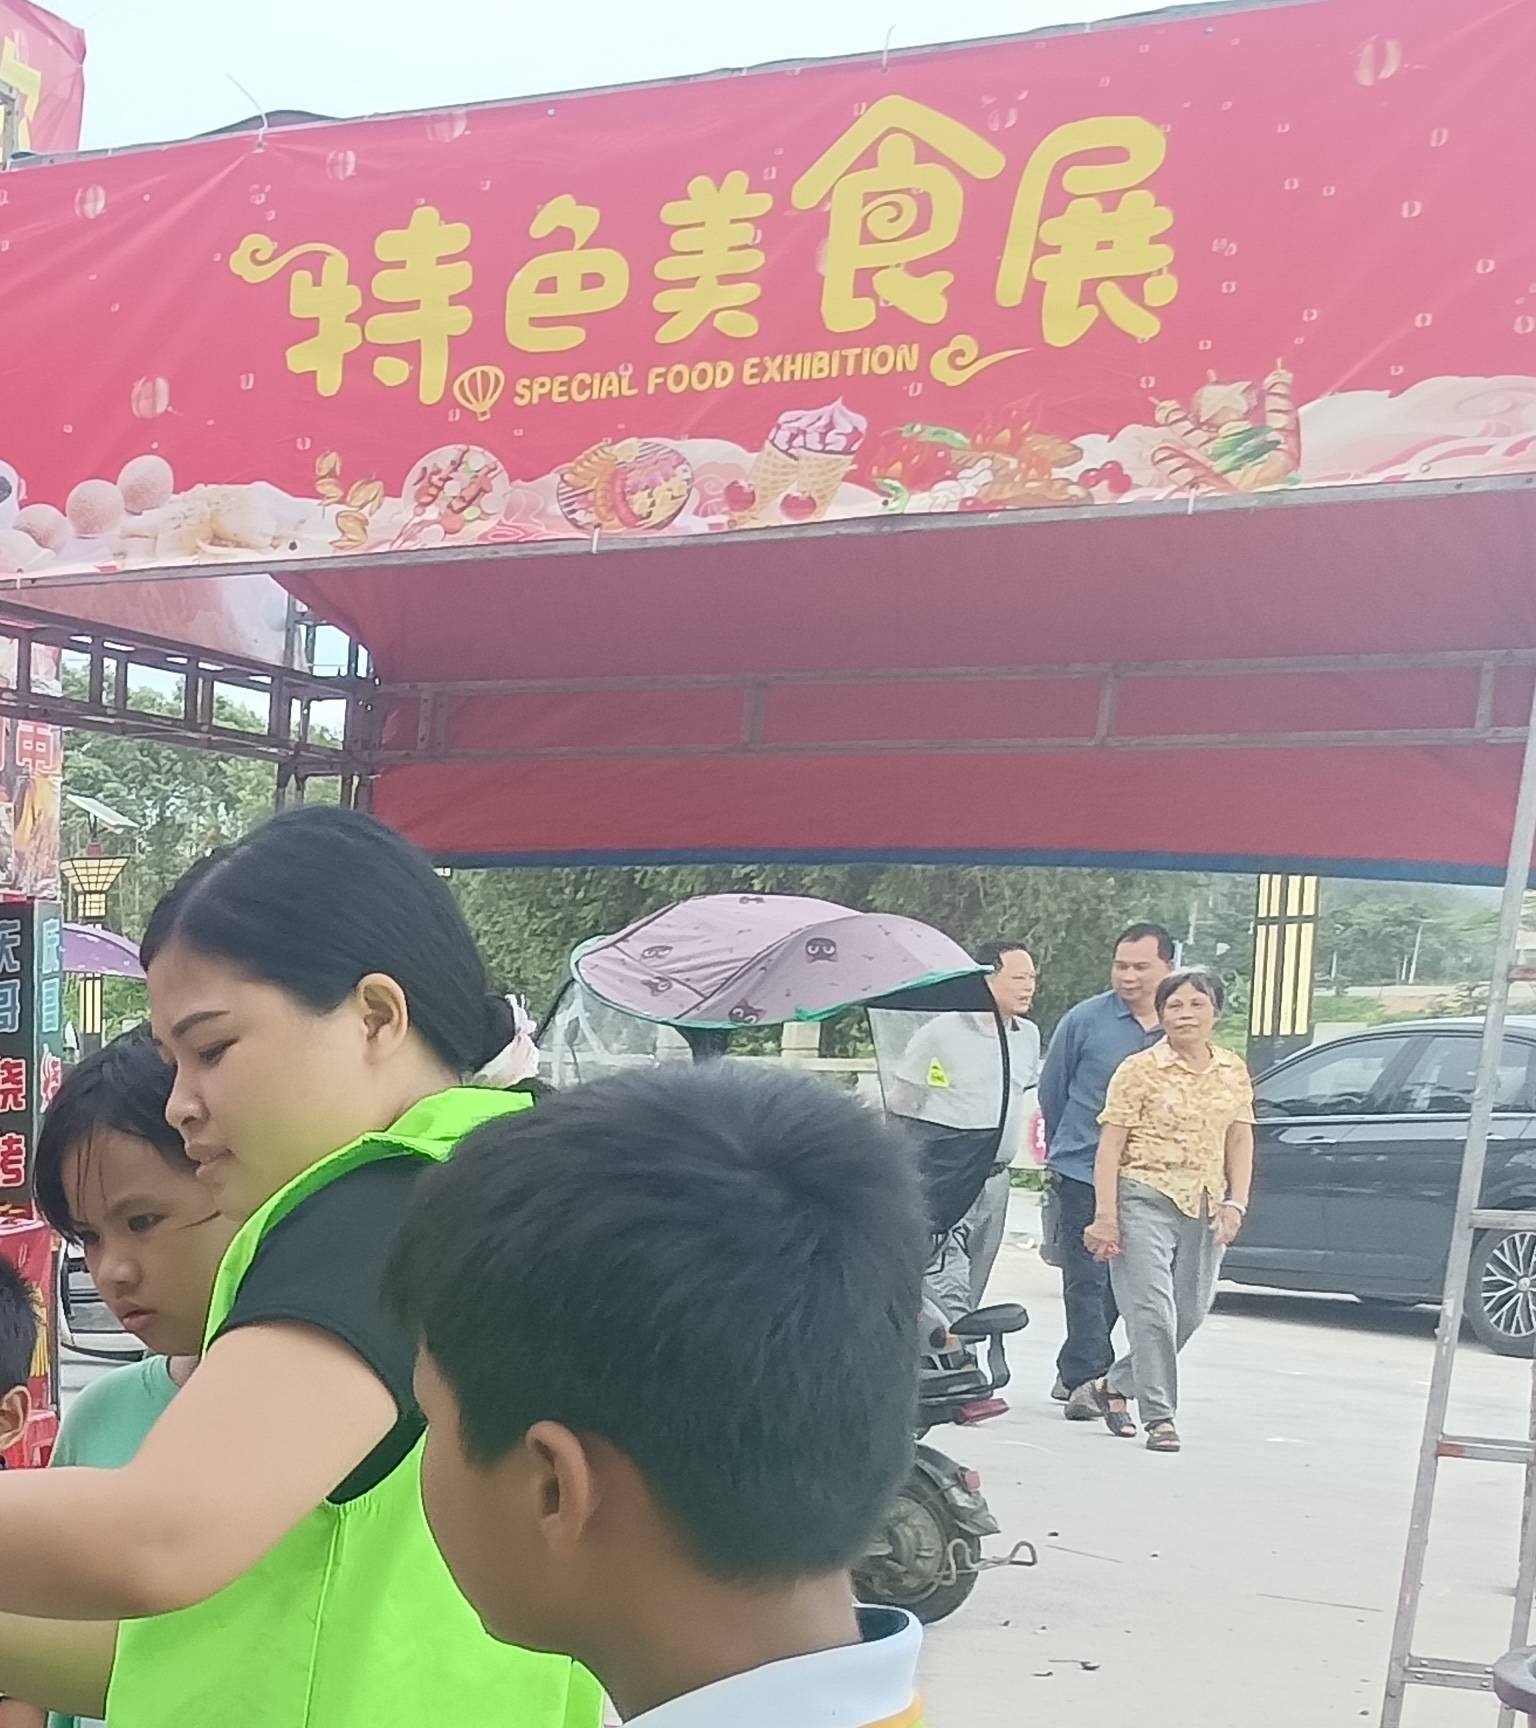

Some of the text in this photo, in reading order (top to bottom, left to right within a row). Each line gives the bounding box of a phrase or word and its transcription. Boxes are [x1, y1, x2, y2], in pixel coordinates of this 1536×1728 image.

[230, 93, 1178, 406] 特色美食展
[513, 342, 920, 408] SPECIAL FOOD EXHIBITION
